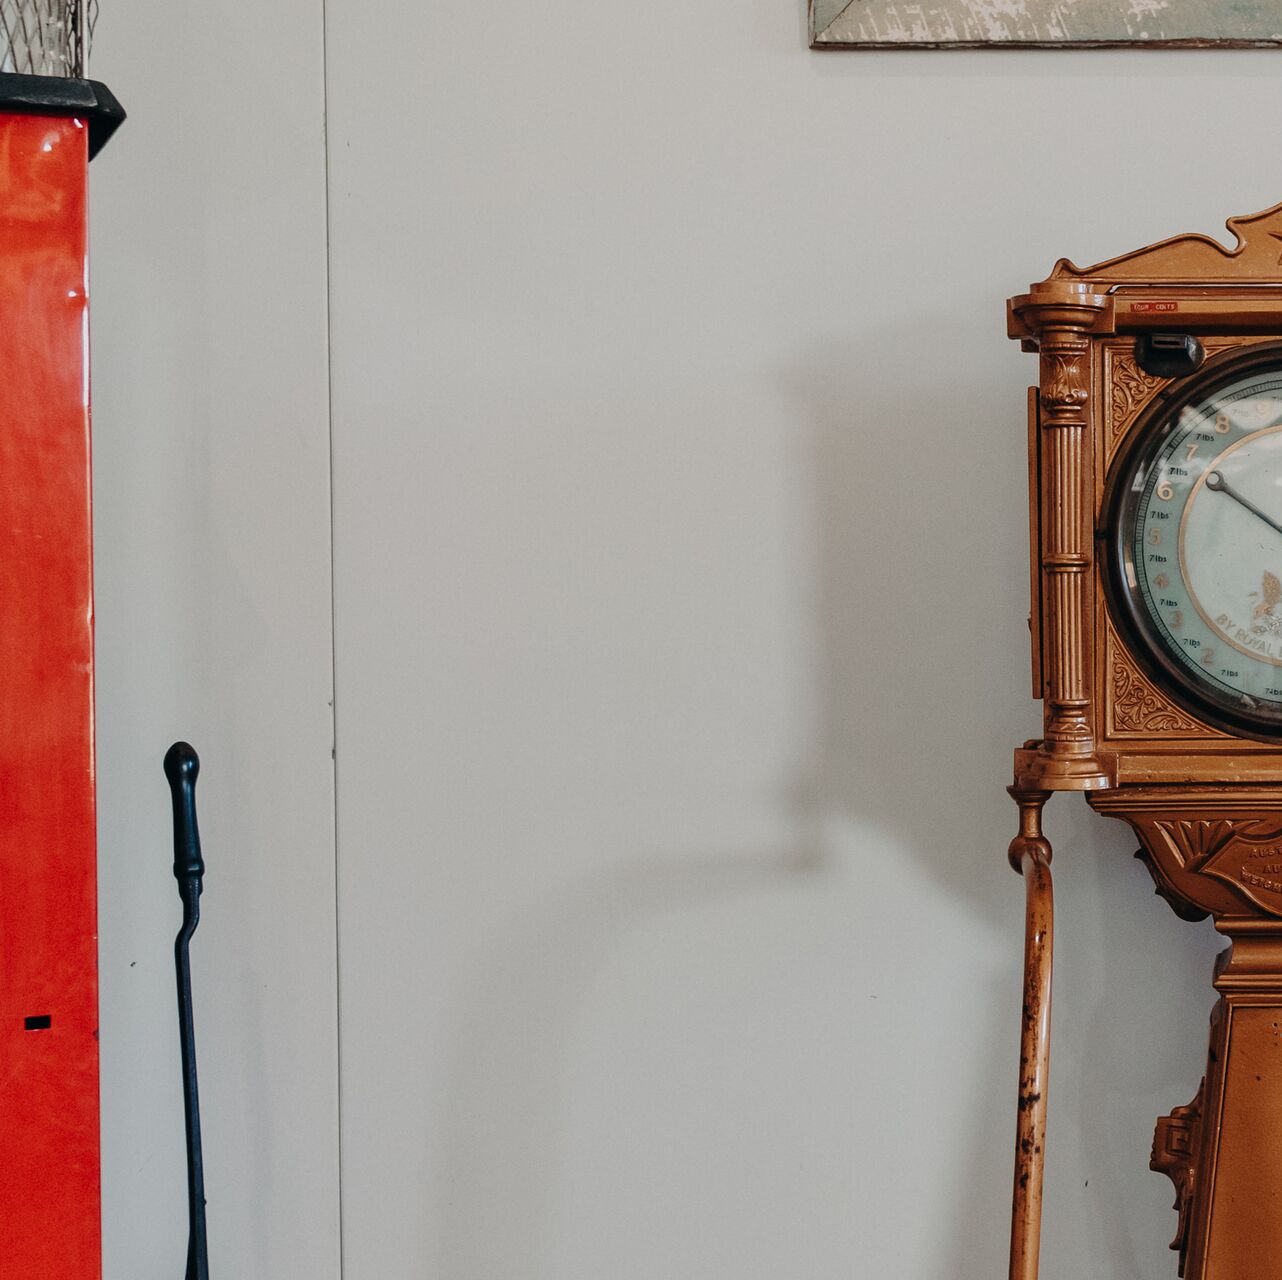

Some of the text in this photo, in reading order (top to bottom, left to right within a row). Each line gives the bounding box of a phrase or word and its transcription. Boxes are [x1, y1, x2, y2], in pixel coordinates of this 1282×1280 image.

[1215, 413, 1231, 434] 8
[1186, 443, 1200, 461] 7
[1157, 480, 1174, 501] 6
[1148, 527, 1162, 546] 5
[1169, 610, 1184, 630] 3
[1216, 612, 1237, 630] BY
[1234, 626, 1274, 656] ROYAL
[1201, 647, 1216, 665] 2
